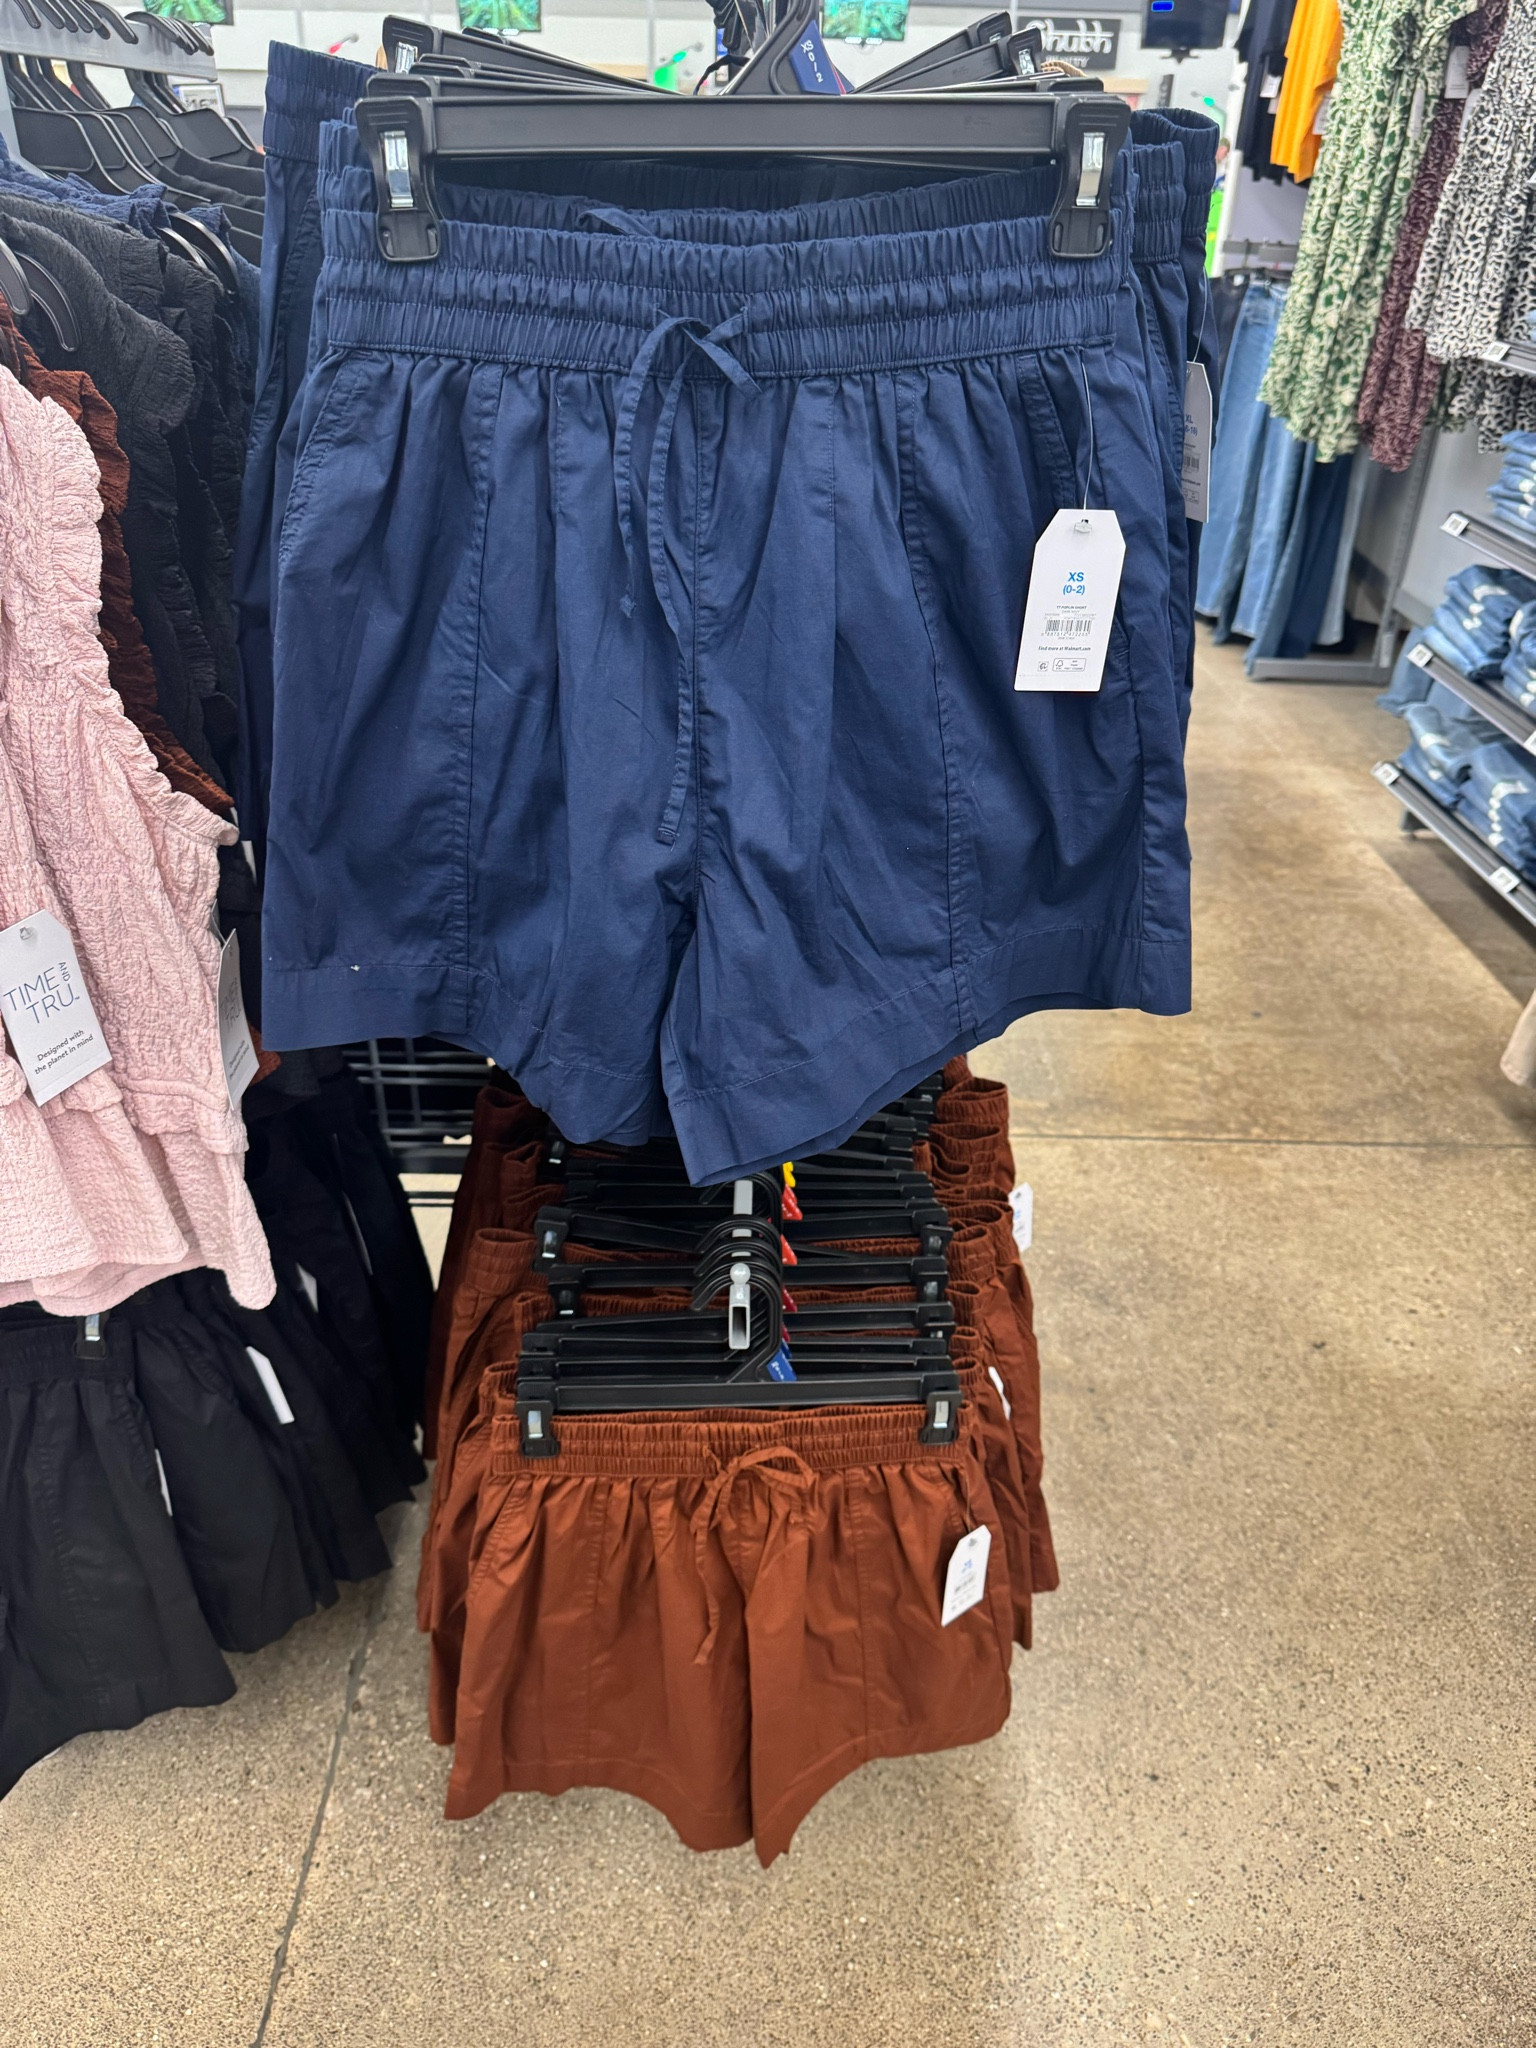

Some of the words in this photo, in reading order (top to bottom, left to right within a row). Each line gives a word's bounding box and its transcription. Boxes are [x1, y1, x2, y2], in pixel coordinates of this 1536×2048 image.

[800, 40, 814, 53] XS
[1062, 584, 1086, 596] (0-2)
[1067, 571, 1085, 582] XS
[3, 966, 60, 1011] TIME
[58, 961, 71, 982] AND
[25, 983, 75, 1024] TRU
[34, 1064, 47, 1075] the
[47, 1050, 69, 1069] planet
[76, 1033, 94, 1049] mind
[36, 1037, 69, 1062] Designed
[69, 1029, 85, 1042] with
